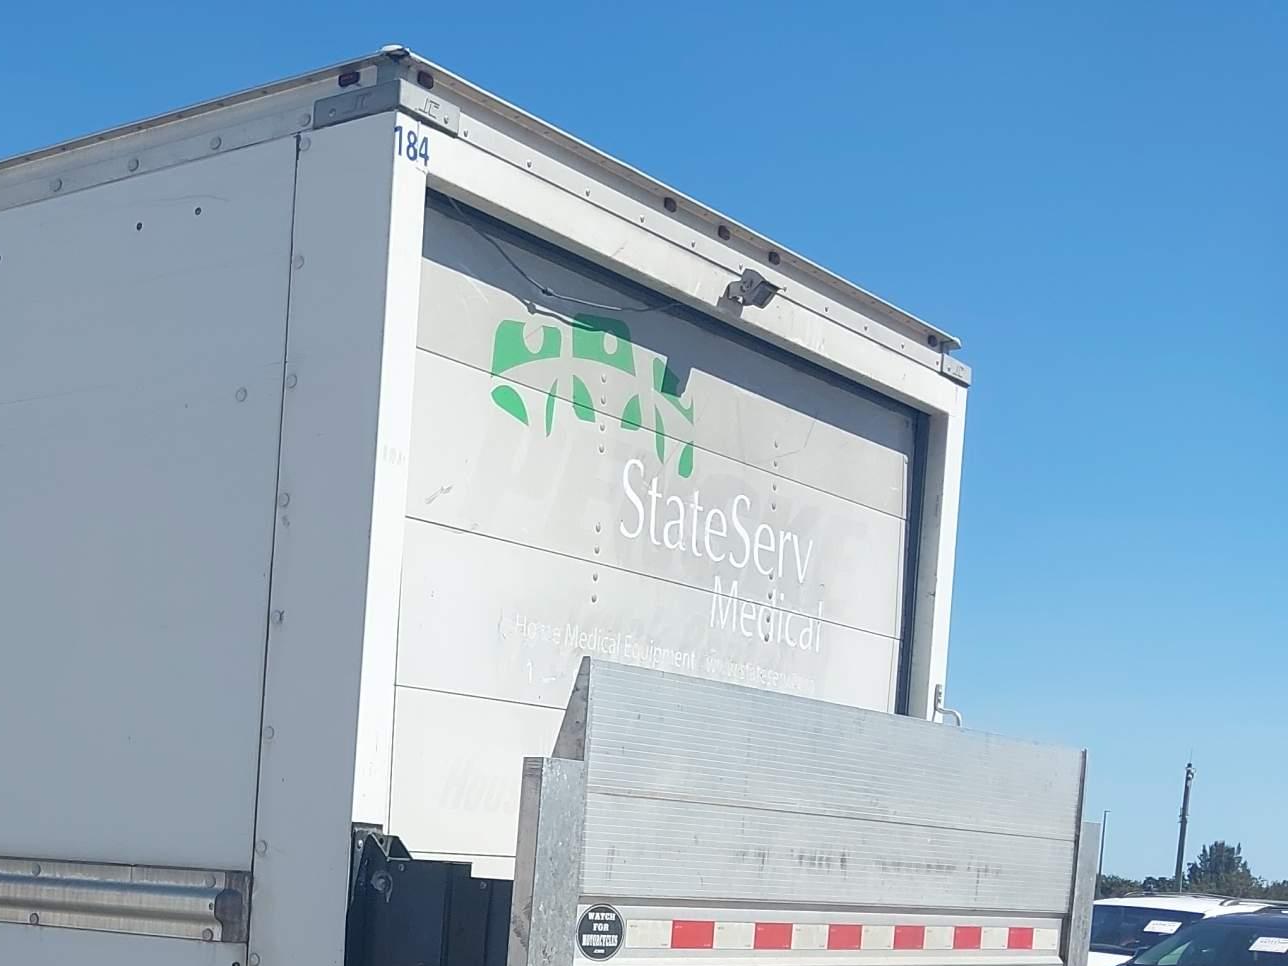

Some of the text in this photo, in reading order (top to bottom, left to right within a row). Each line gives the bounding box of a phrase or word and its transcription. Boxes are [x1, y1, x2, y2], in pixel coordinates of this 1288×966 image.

[394, 125, 429, 167] 184
[620, 458, 813, 583] StateServ
[711, 575, 824, 652] Medical
[564, 622, 620, 657] Medical
[623, 634, 696, 670] Equipment
[588, 912, 616, 921] WATCH
[592, 922, 609, 931] FOR
